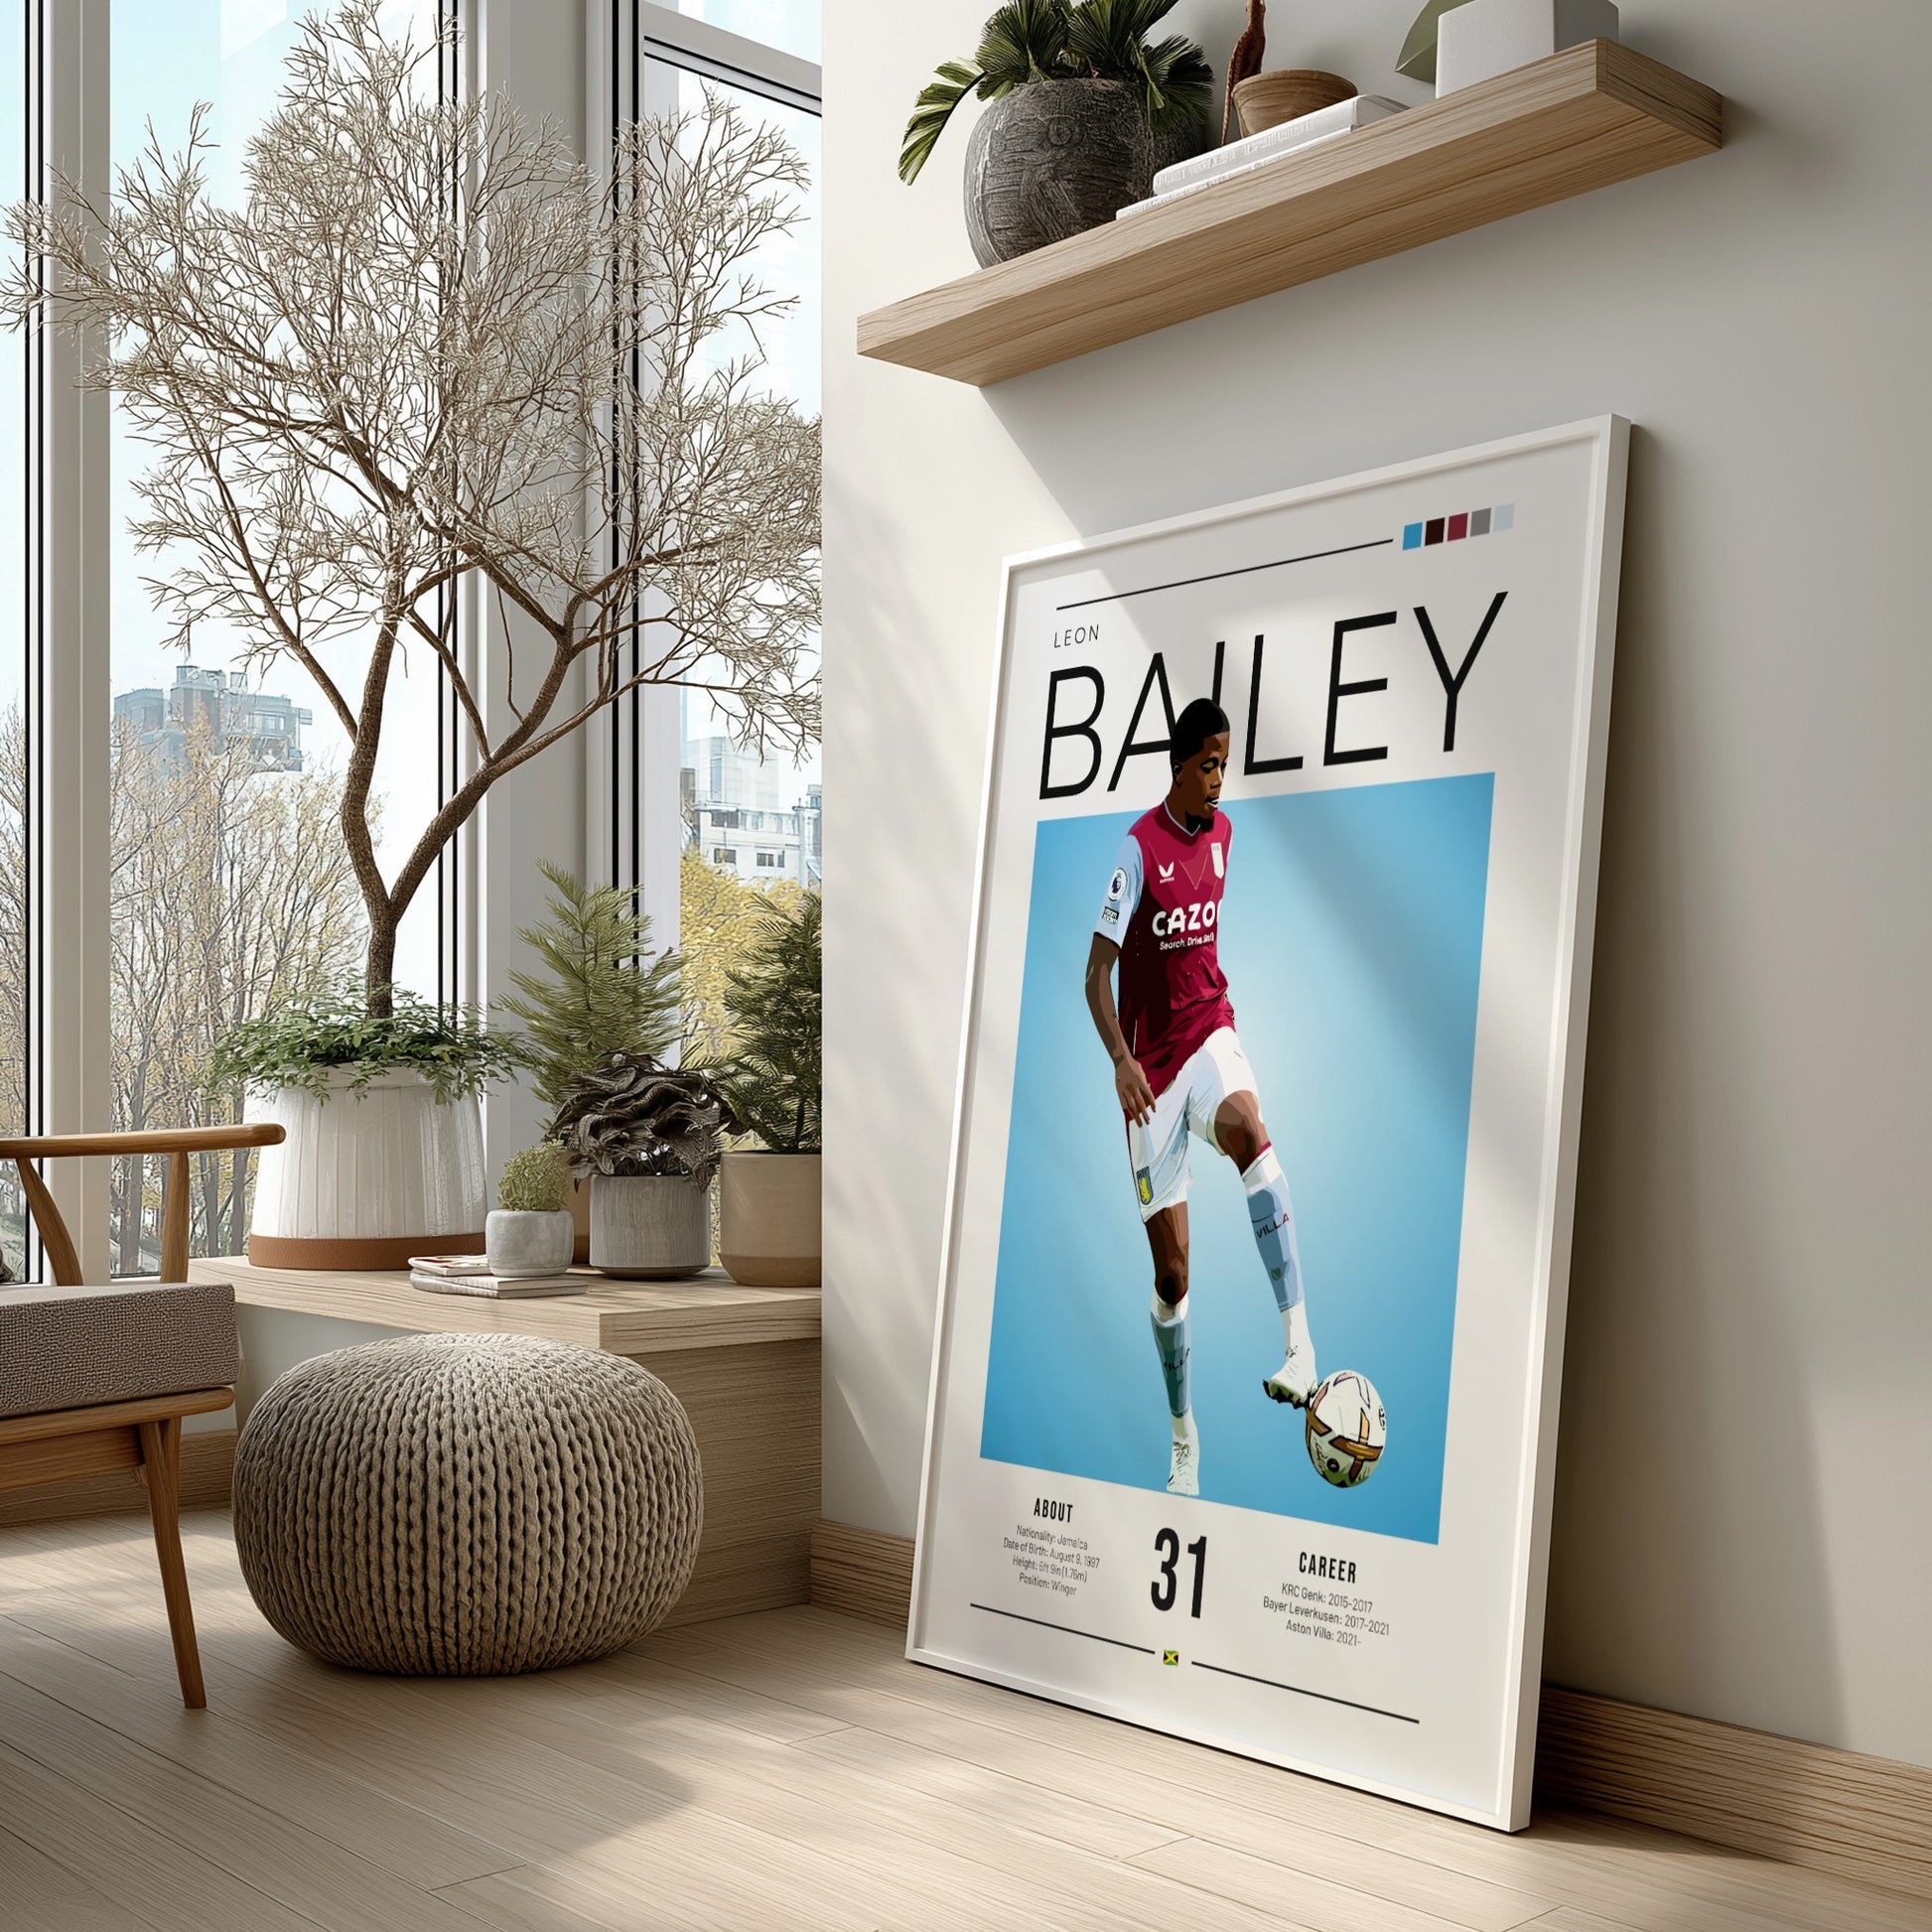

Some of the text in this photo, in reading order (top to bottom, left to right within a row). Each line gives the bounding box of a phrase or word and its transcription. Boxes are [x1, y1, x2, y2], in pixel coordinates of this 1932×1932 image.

[1053, 623, 1100, 649] LEON
[1034, 1497, 1073, 1523] ABOUT
[1003, 1537, 1020, 1551] Date
[1020, 1542, 1029, 1552] of
[1029, 1543, 1048, 1557] Birth:
[1049, 1549, 1074, 1564] August
[1016, 1525, 1088, 1551] Nationality: Jamaica
[1013, 1556, 1038, 1571] Height:
[1151, 1527, 1207, 1619] 31
[1299, 1551, 1357, 1584] CAREER
[1019, 1573, 1077, 1596] Position: Winger
[1282, 1583, 1373, 1613] KRC Genk: 2015-2017
[1263, 1595, 1390, 1636] Bayer Leverkusen: 2017-2021
[1286, 1619, 1362, 1647] Aston Villa: 2021-
